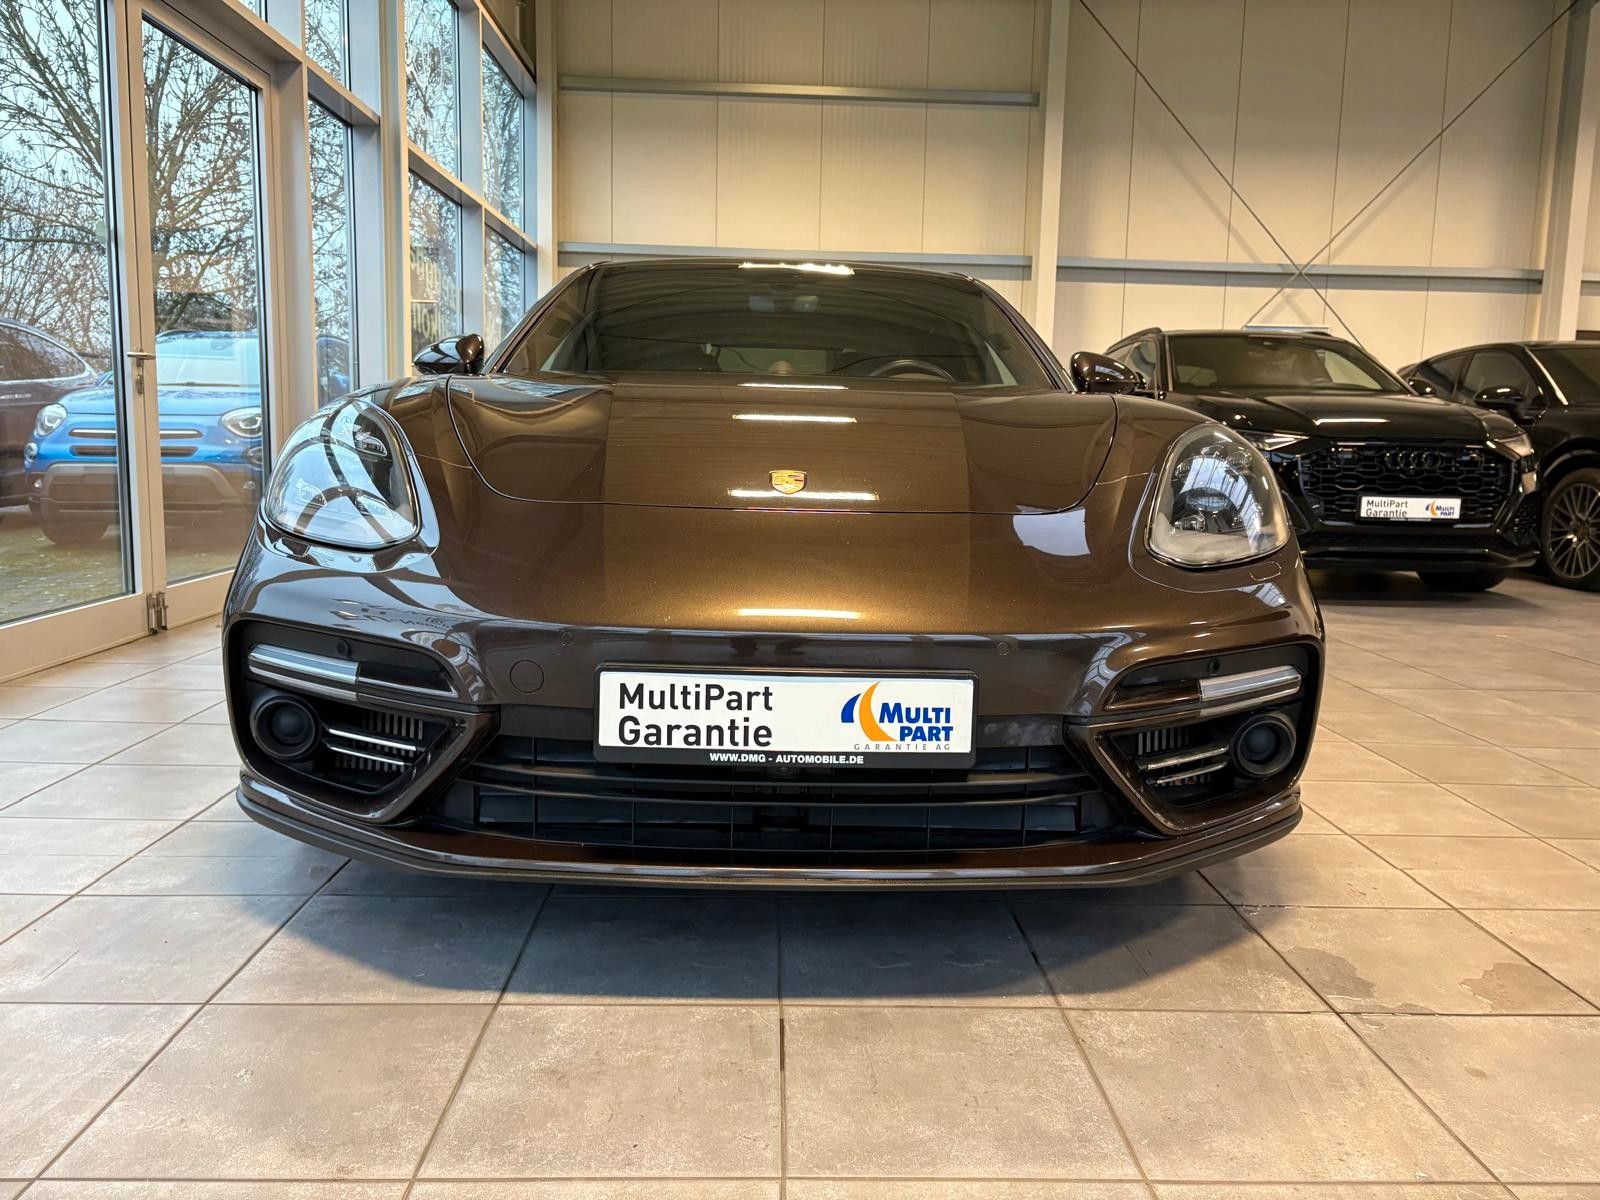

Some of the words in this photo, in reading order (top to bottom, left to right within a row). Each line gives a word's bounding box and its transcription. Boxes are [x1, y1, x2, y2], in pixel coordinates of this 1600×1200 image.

[1366, 500, 1408, 508] MultiPart
[1365, 508, 1408, 518] Garantie
[618, 682, 773, 711] MultiPart
[878, 702, 951, 724] MULTI
[618, 715, 773, 747] Garantie
[899, 725, 954, 742] PART
[853, 743, 928, 751] GARANTIE
[935, 743, 951, 751] AG
[709, 752, 766, 763] WWW.DMG
[775, 754, 864, 764] AUTOMOBILE.DE
